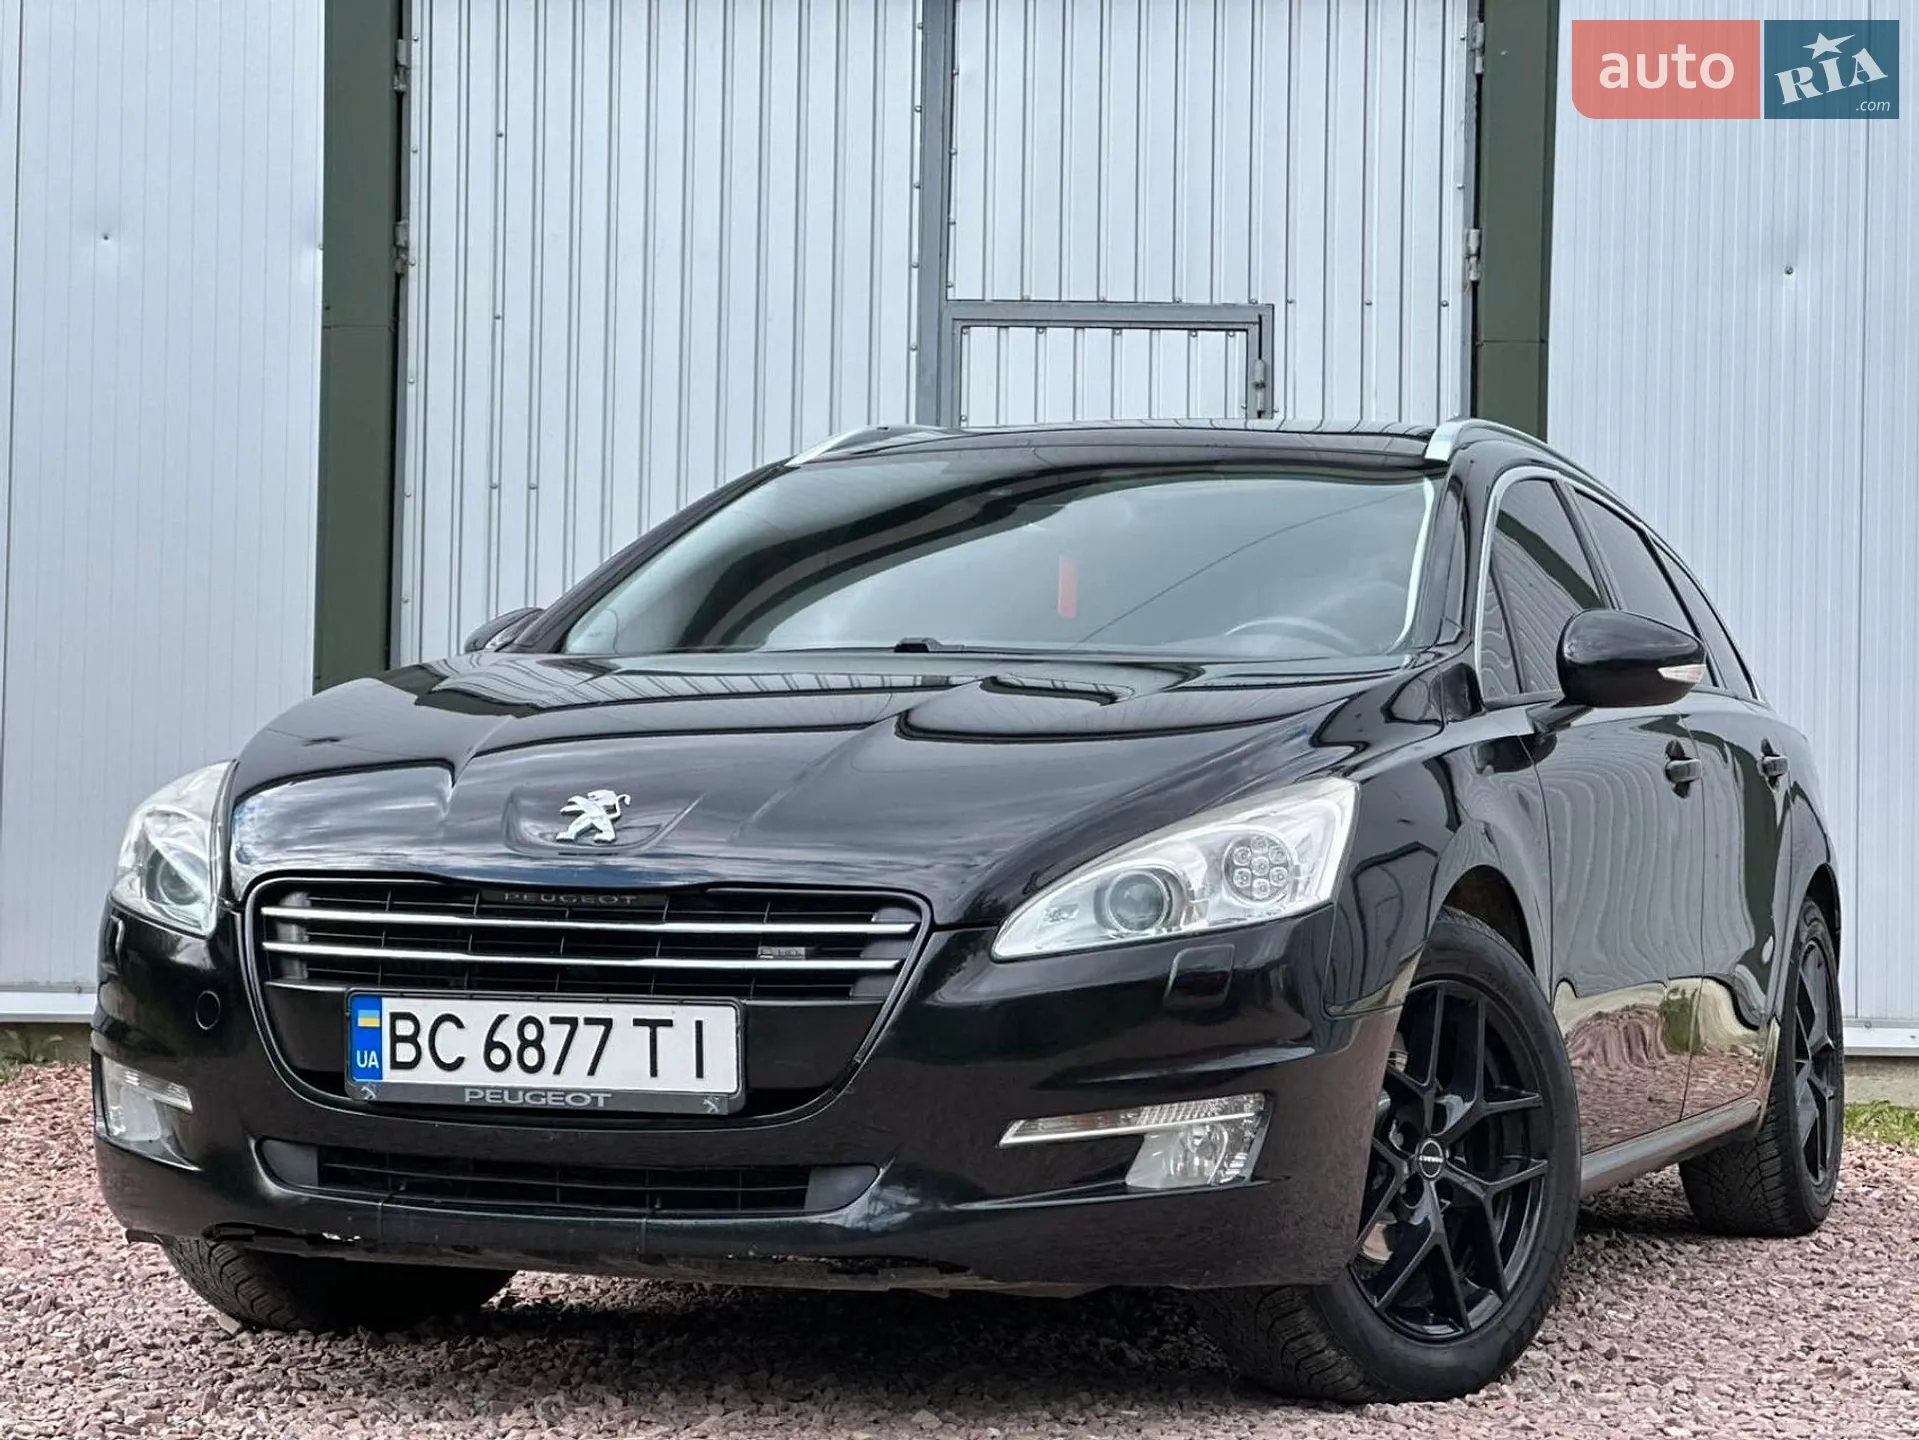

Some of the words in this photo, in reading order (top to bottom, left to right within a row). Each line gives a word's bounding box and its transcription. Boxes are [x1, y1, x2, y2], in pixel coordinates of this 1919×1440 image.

[504, 891, 637, 905] PEUGEOT
[389, 1011, 466, 1072] BC
[483, 1014, 614, 1076] 6877
[356, 1049, 379, 1069] UA
[464, 1087, 612, 1108] PEUGEOT
